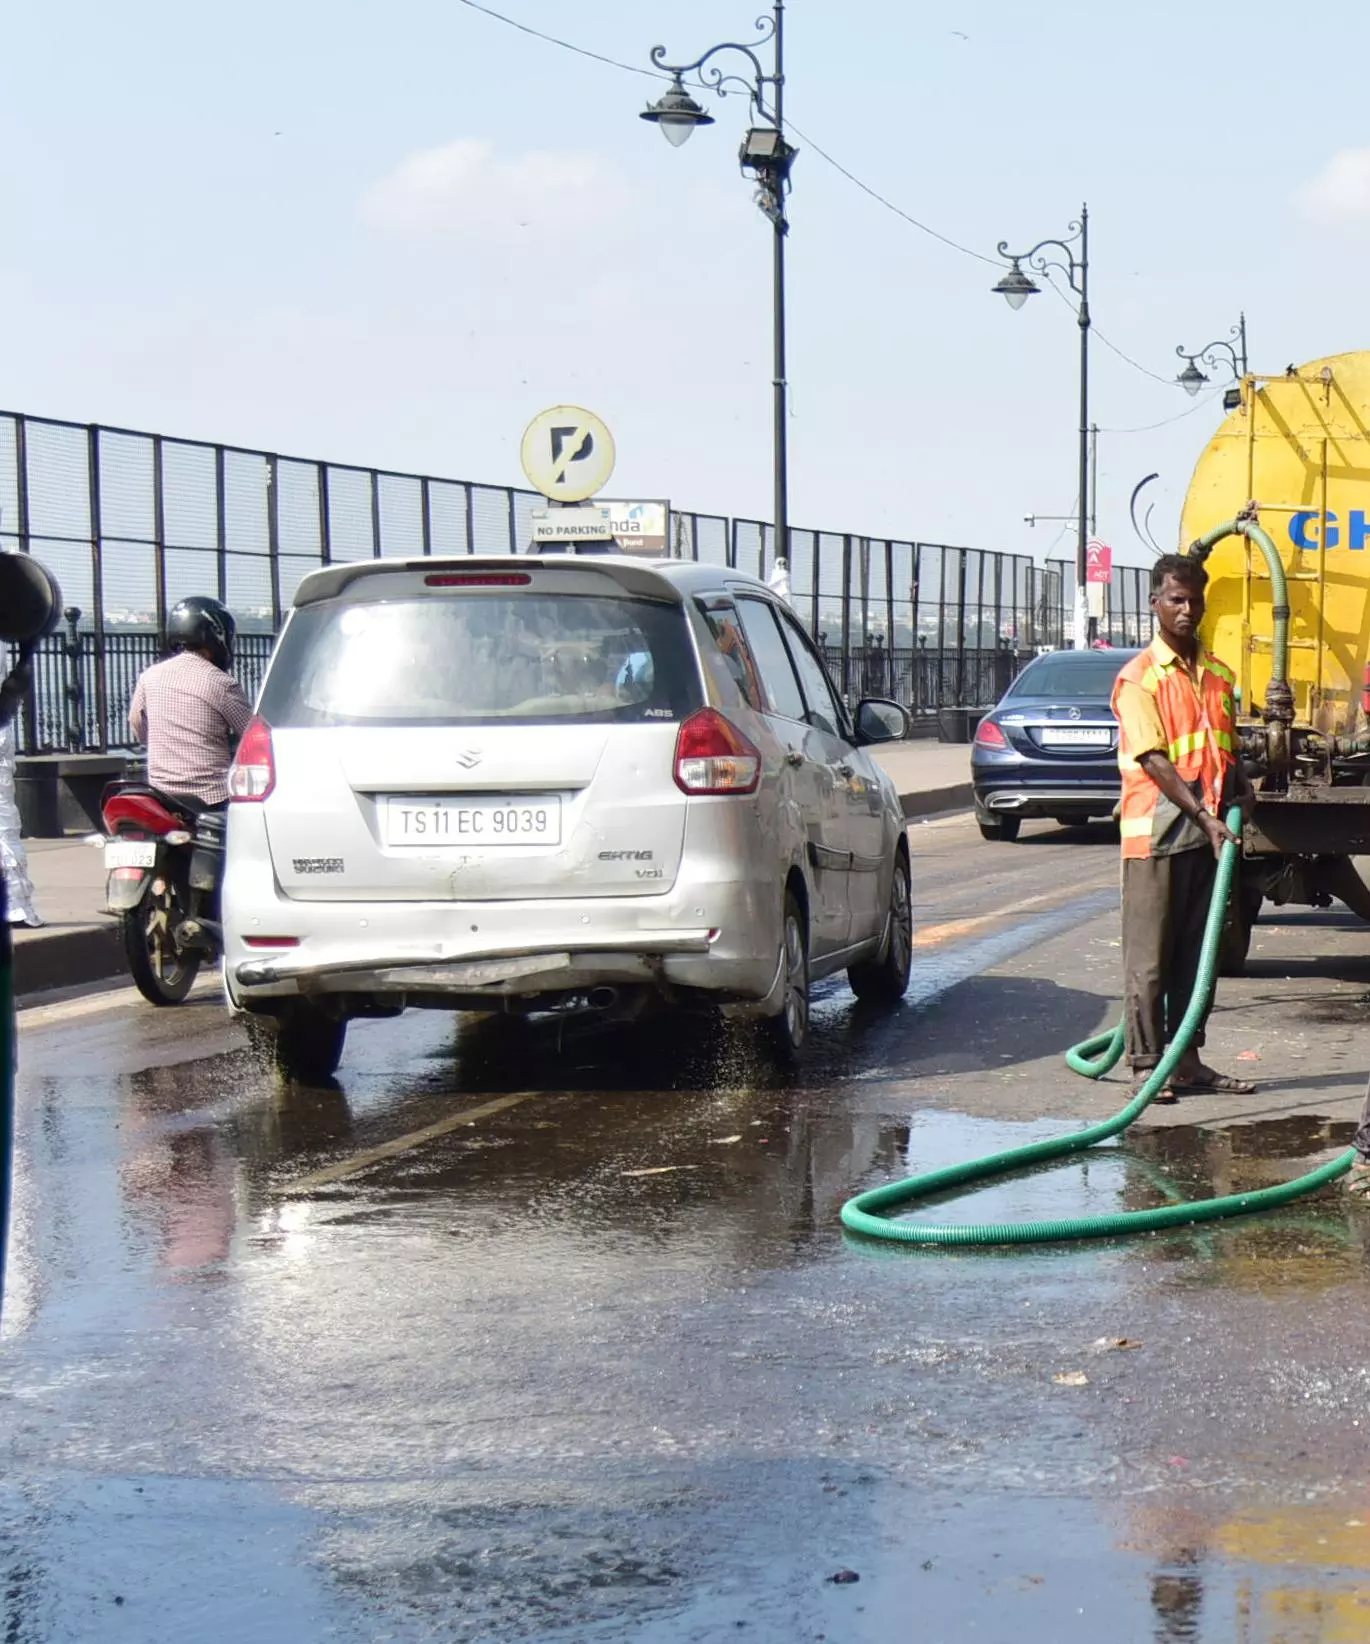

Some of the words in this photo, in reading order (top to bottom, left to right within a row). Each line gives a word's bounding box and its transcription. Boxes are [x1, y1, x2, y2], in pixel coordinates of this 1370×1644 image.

[537, 527, 553, 535] NO
[556, 525, 606, 535] PARKING
[644, 709, 673, 717] ABS
[401, 811, 426, 833] TS
[433, 811, 449, 833] 11
[458, 811, 483, 833] EC
[493, 810, 546, 833] 9039
